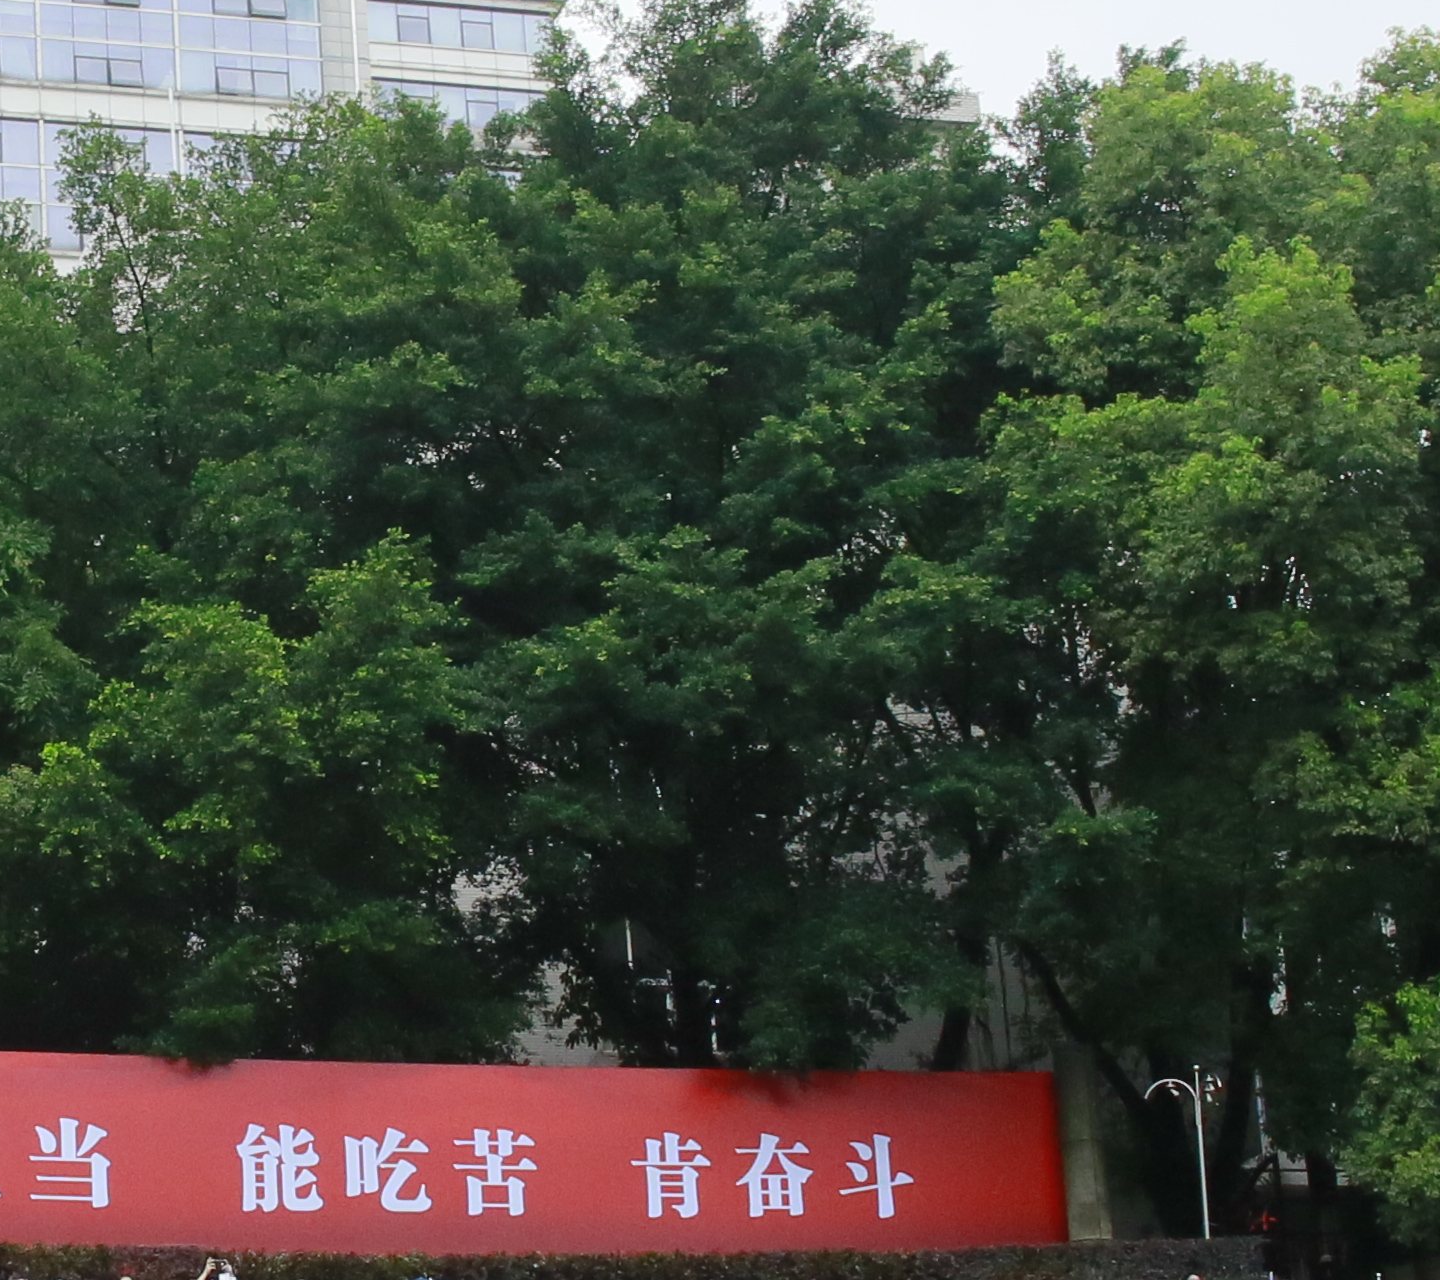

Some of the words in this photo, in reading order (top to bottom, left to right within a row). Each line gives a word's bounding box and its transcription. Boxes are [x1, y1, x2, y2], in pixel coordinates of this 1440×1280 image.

[235, 1122, 538, 1218] 能吃苦
[629, 1130, 916, 1221] 肯奋斗
